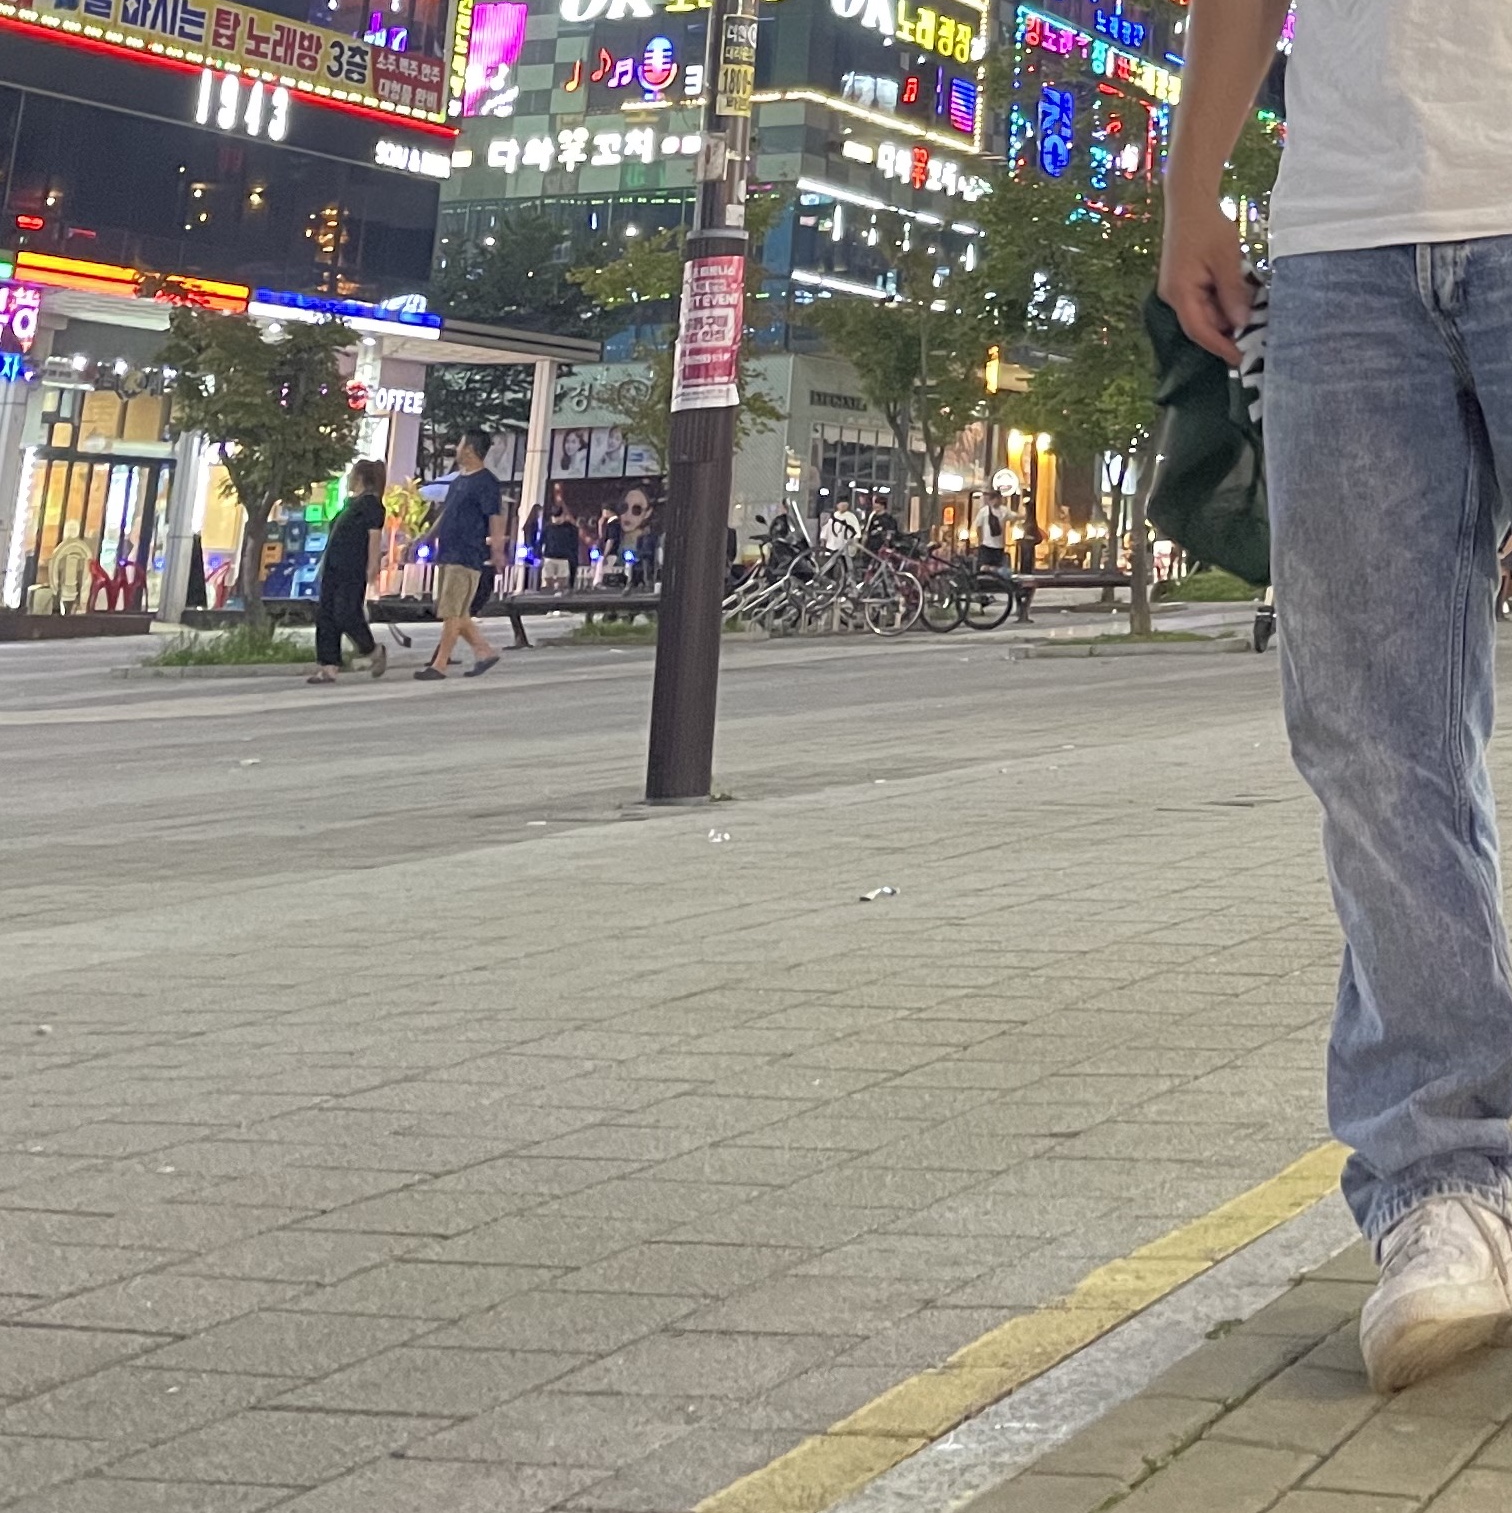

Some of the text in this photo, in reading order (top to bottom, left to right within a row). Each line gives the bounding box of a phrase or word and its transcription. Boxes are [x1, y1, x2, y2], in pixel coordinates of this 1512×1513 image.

[213, 4, 245, 50] 탑
[245, 15, 324, 72] 노래방
[325, 38, 370, 85] 3층
